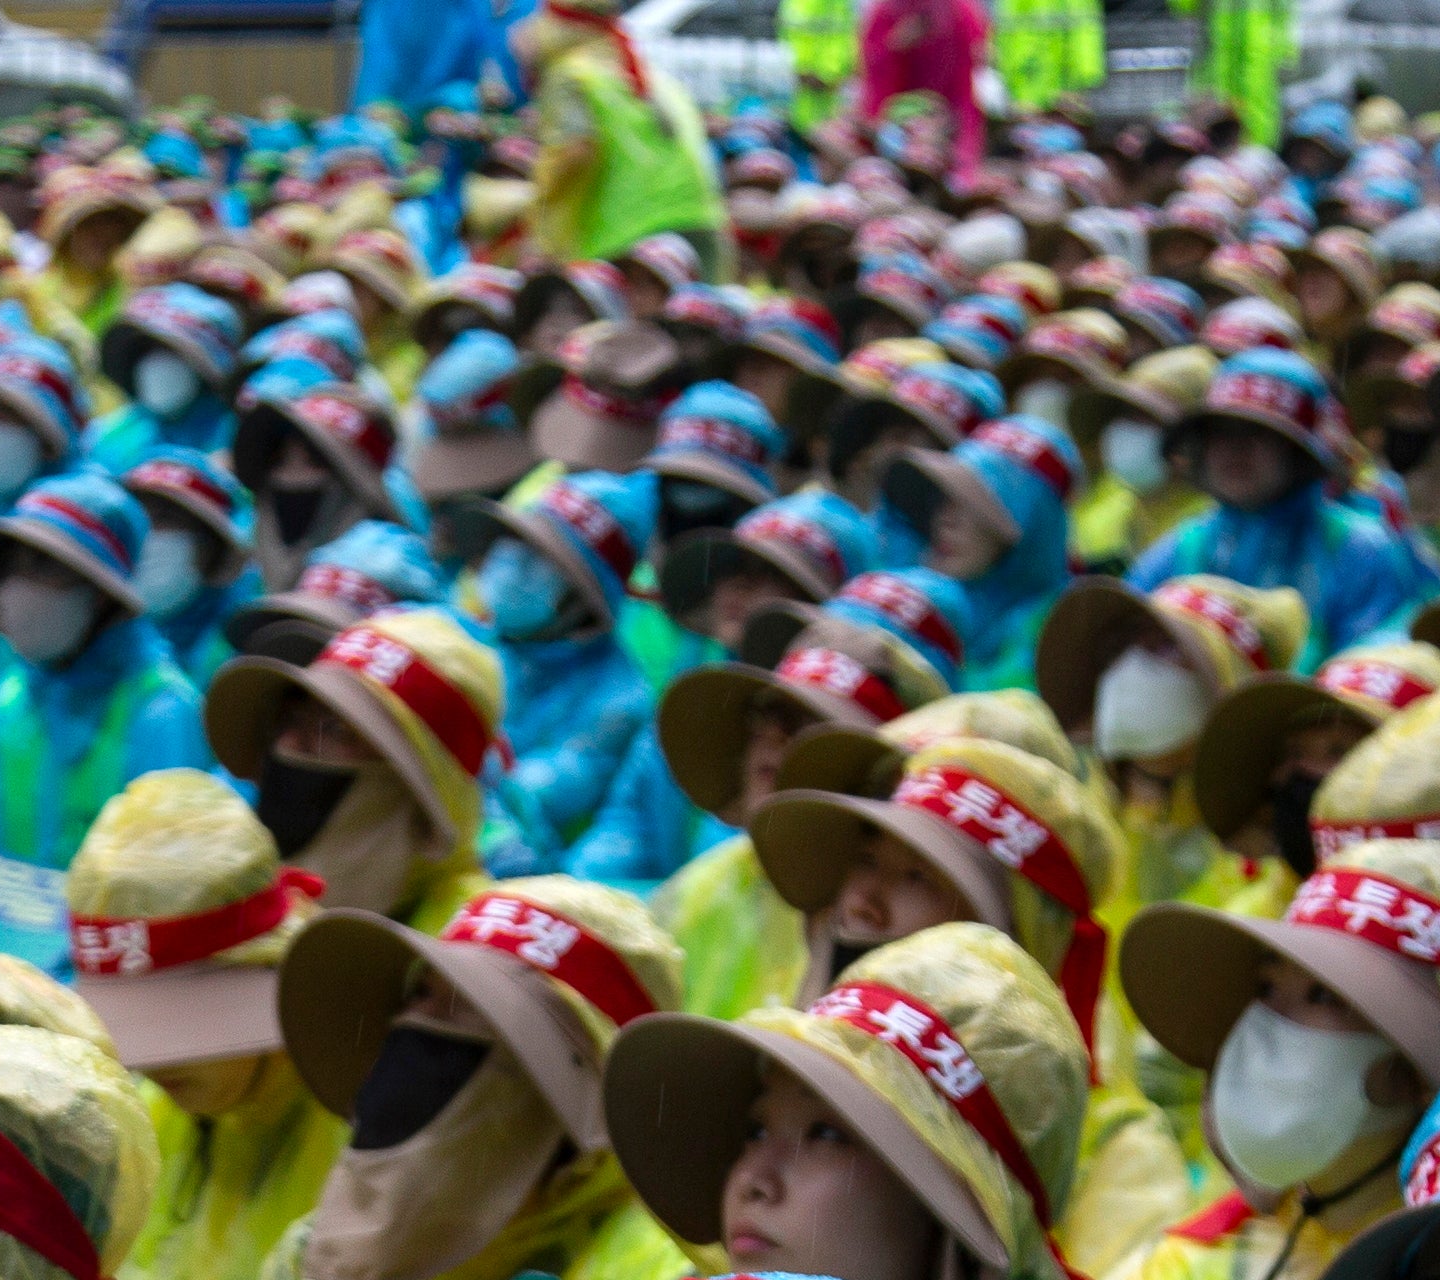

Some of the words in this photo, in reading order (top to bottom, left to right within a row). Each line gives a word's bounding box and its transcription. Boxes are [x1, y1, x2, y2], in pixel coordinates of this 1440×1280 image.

[941, 779, 1050, 869] 투쟁
[76, 921, 152, 977] 투쟁
[473, 896, 580, 970] 투쟁
[869, 1000, 985, 1100] 투쟁
